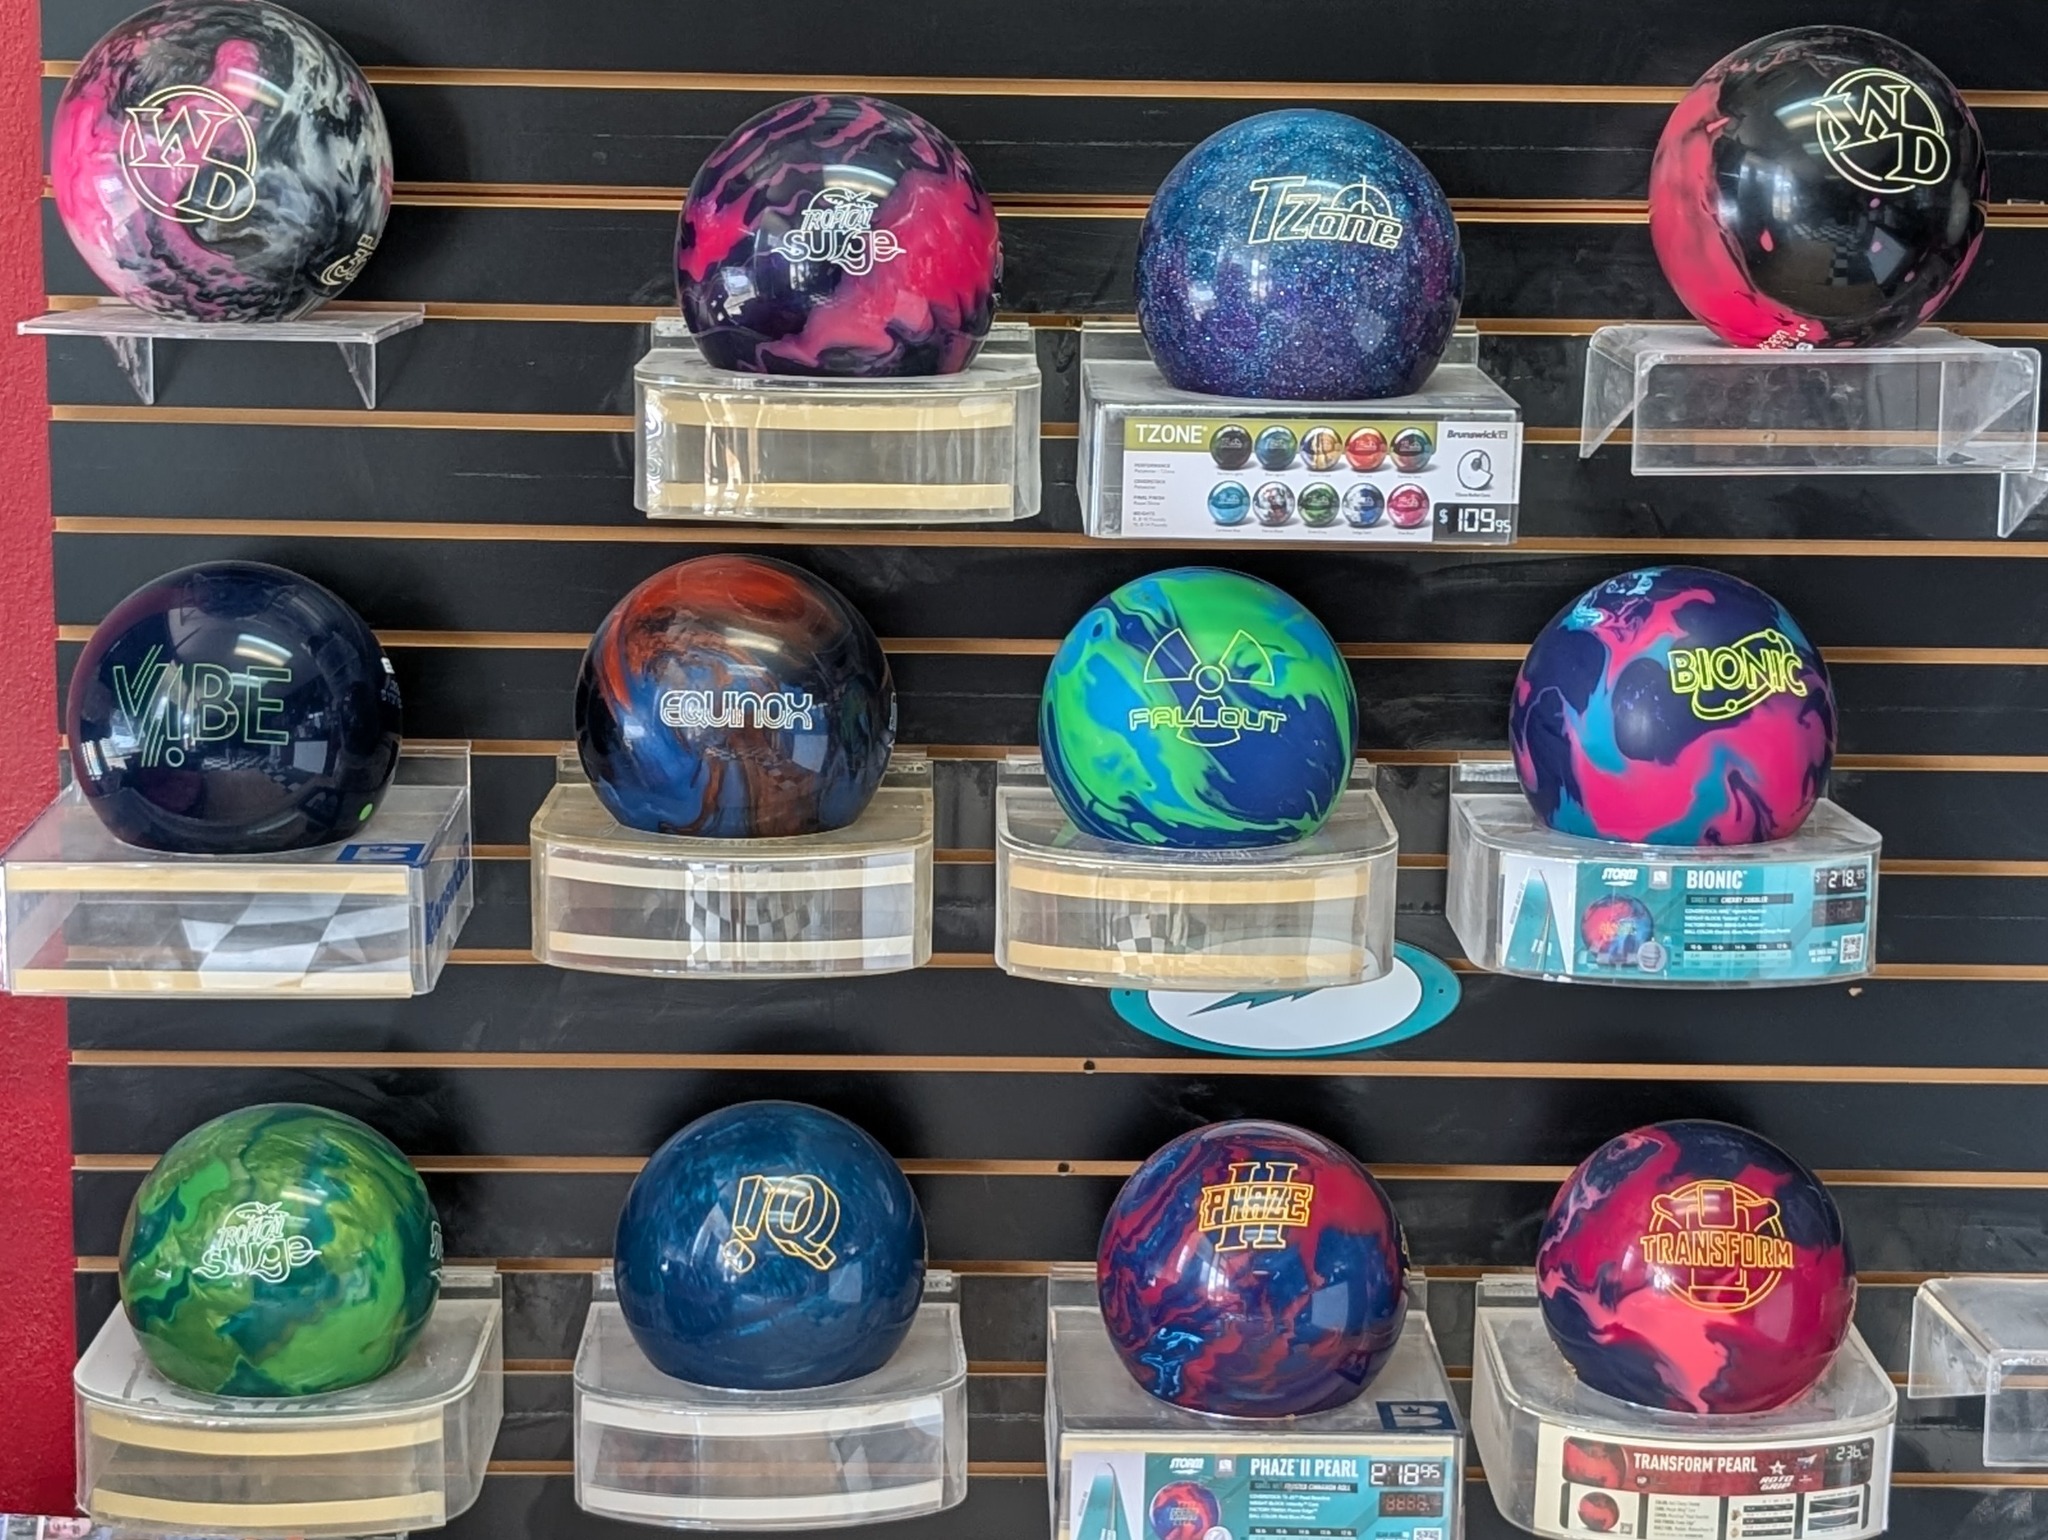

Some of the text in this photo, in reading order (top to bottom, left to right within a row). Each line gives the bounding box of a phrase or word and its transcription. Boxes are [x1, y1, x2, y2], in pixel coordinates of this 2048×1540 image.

[1447, 429, 1499, 439] Brunswick
[1668, 646, 1808, 697] BIONIC
[113, 662, 292, 767] VIBE
[1129, 706, 1288, 733] FALLOUT
[1601, 867, 1639, 881] STORM
[1686, 869, 1743, 890] BIONIC
[1199, 1182, 1314, 1231] PHAZE
[1640, 1230, 1795, 1269] TRANSFORM
[1169, 1457, 1205, 1470] STORM
[1300, 1458, 1310, 1477] II
[1314, 1458, 1359, 1478] PEARL
[1717, 1456, 1759, 1473] PEARL
[1759, 1475, 1795, 1484] ROTO
